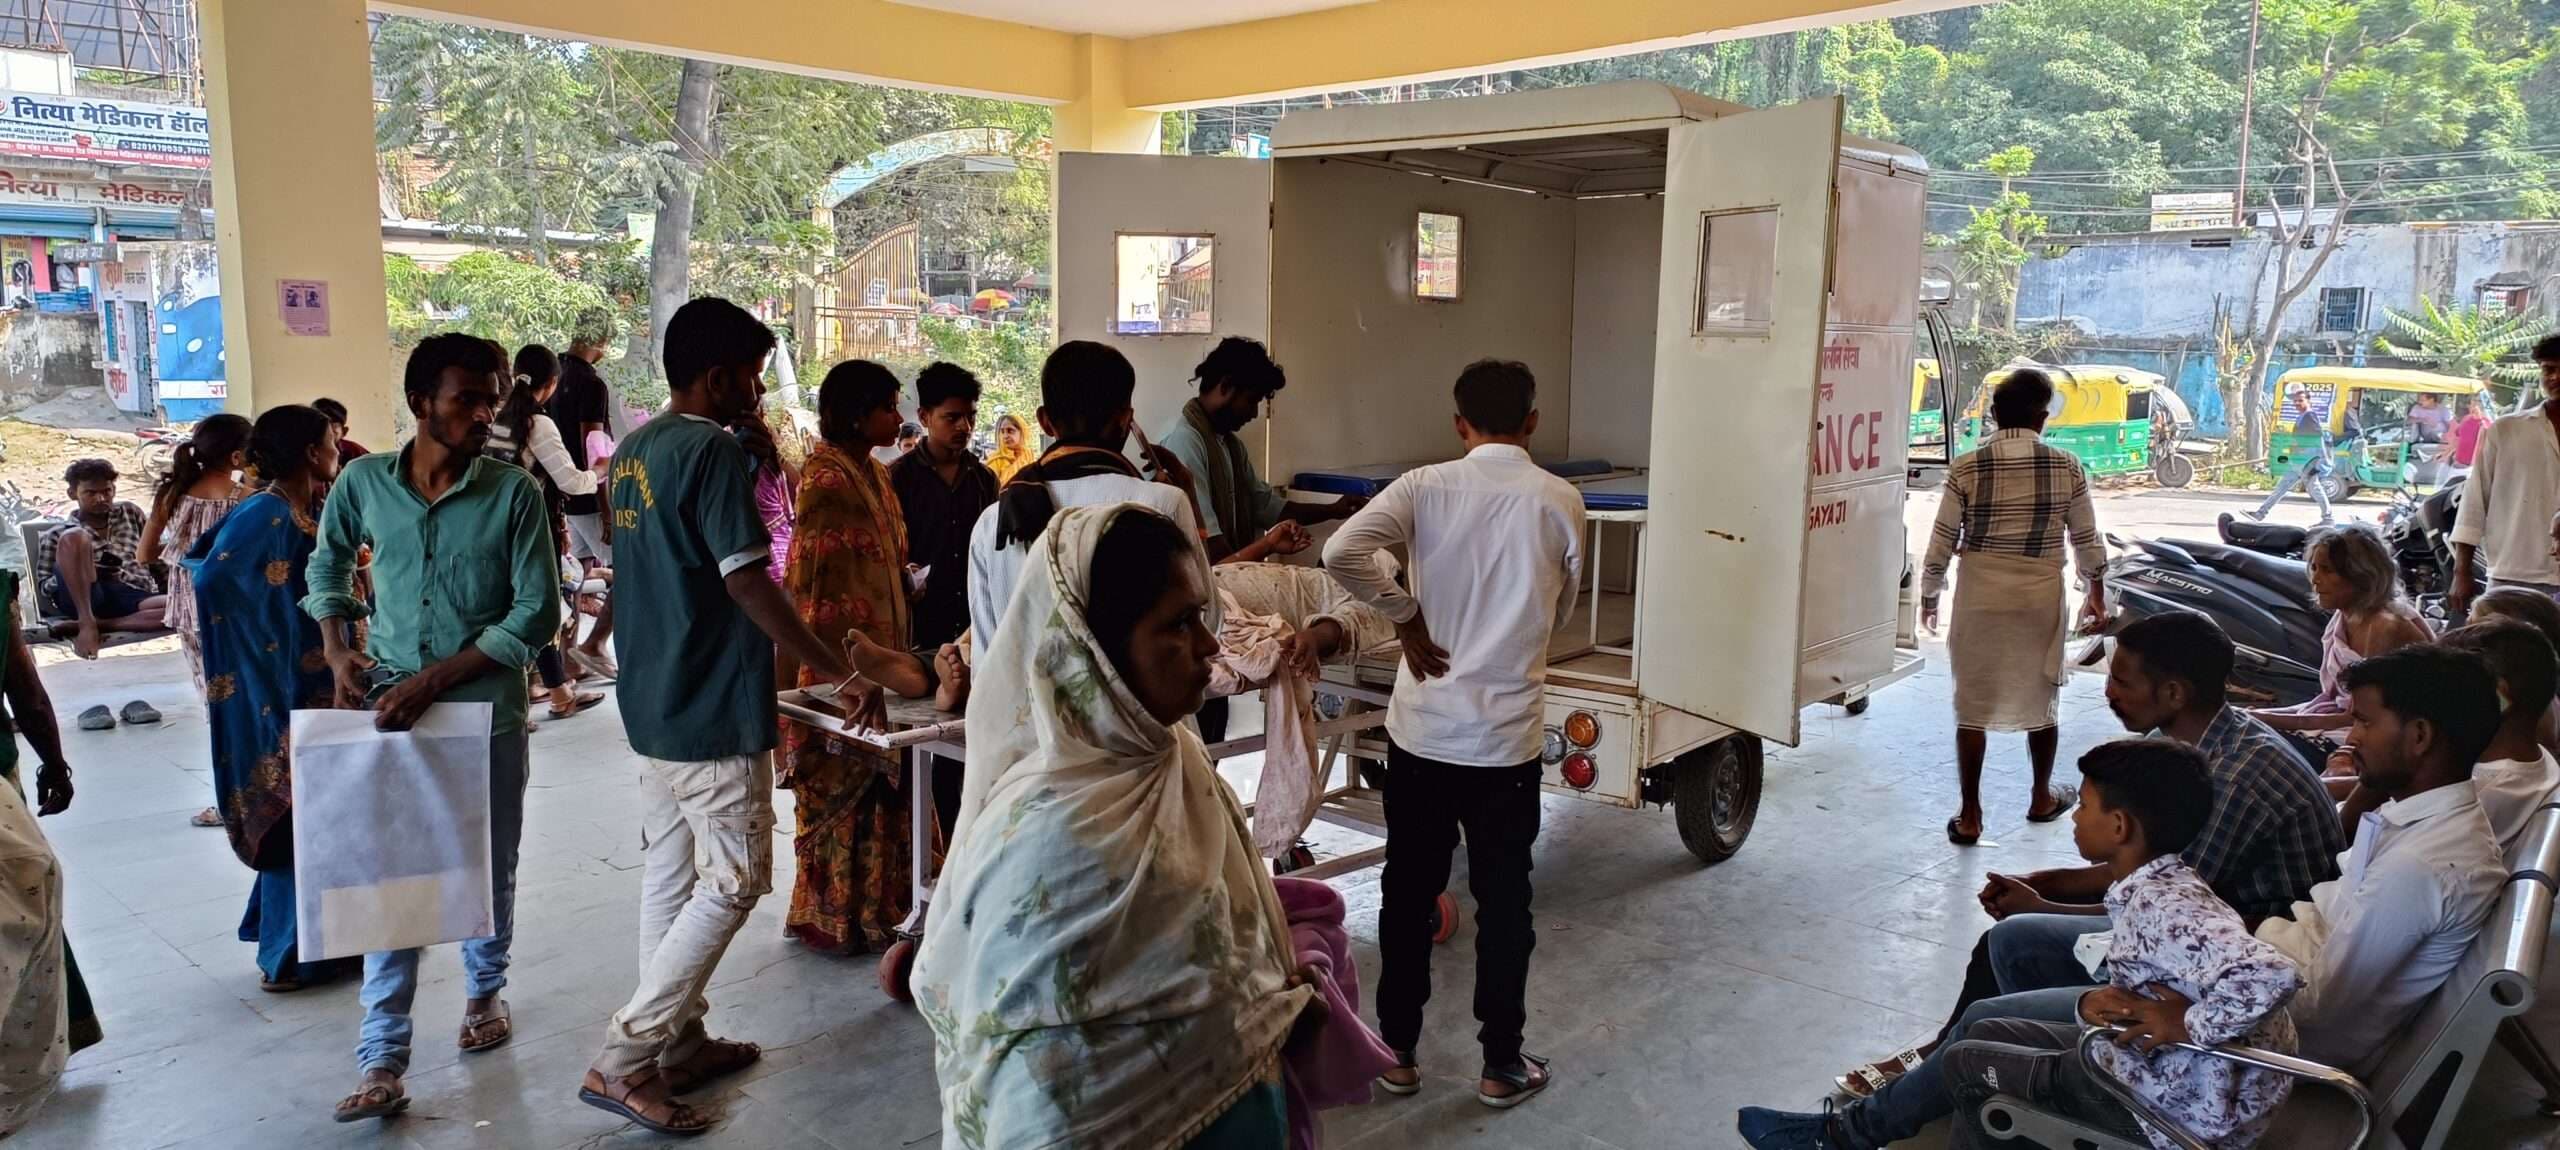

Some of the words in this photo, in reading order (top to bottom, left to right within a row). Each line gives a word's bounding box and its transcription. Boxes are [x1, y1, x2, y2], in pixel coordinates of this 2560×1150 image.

[11, 96, 75, 122] नित्या
[79, 102, 164, 130] मेडिकल
[2305, 383, 2333, 392] 2025
[1812, 411, 1882, 476] ANCE
[2145, 569, 2214, 595] MAESTRO
